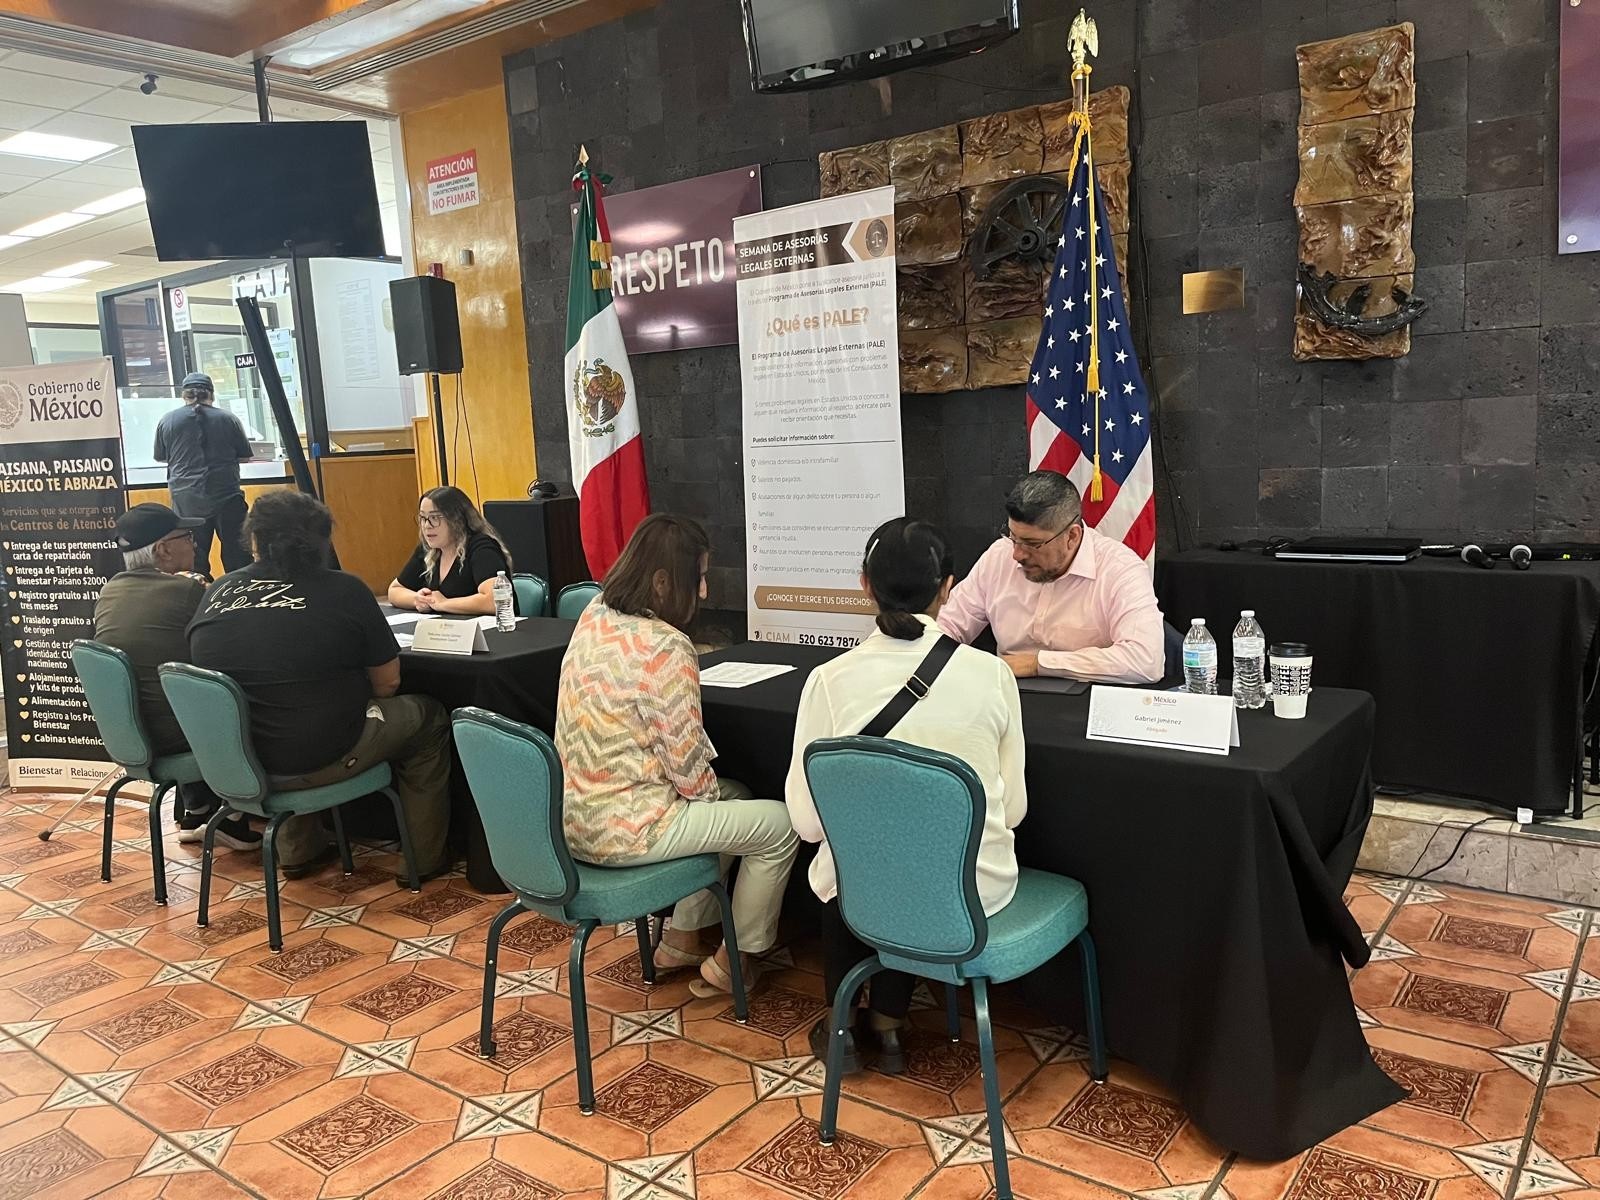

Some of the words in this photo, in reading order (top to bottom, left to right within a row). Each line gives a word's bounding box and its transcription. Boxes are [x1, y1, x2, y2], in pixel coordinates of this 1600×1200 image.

[429, 156, 474, 180] ATENCIÓN
[432, 198, 445, 210] NO
[446, 190, 477, 207] FUMAR
[740, 244, 771, 258] SEMANA
[772, 242, 783, 252] DE
[785, 233, 829, 250] ASESORÍAS
[611, 237, 725, 296] RESPETO
[740, 258, 773, 274] LEGALES
[774, 253, 815, 269] EXTERNAS
[769, 294, 793, 303] Programa
[766, 314, 801, 337] ¿Qué
[804, 316, 820, 330] es
[823, 307, 869, 328] PALE?
[757, 351, 782, 361] Programa
[783, 349, 790, 357] de
[838, 343, 865, 351] Externas
[866, 340, 886, 350] (PALE)
[236, 355, 254, 367] CAJA
[28, 381, 84, 396] Gobierno
[86, 378, 102, 392] de
[29, 394, 103, 422] México
[788, 434, 817, 442] información
[0, 461, 51, 477] AISANA,
[53, 457, 114, 474] PAISANO
[46, 478, 62, 491] TE
[64, 475, 118, 491] ABRAZA
[1, 506, 40, 517] Servicios
[41, 507, 57, 518] que
[69, 506, 99, 517] otorgan
[102, 506, 116, 514] en
[10, 519, 54, 531] Centros
[56, 518, 70, 530] de
[73, 517, 119, 531] Atenció
[11, 541, 41, 552] Entrega
[42, 541, 52, 550] de
[54, 541, 66, 550] tus
[68, 540, 119, 553] pertenencia
[12, 552, 31, 561] carta
[33, 551, 44, 560] de
[45, 550, 91, 562] repatriación
[14, 566, 44, 577] Entrega
[45, 566, 55, 575] de
[56, 566, 82, 577] Tarjeta
[83, 566, 94, 575] de
[16, 577, 51, 586] Bienestar
[53, 577, 82, 586] Paisano
[18, 591, 48, 602] Registro
[49, 591, 81, 602] gratuito
[82, 591, 90, 600] al
[766, 593, 794, 602] ¡CONOCE
[794, 594, 799, 602] Y
[800, 595, 822, 604] EJERCE
[822, 596, 835, 605] TUS
[20, 602, 33, 610] tres
[34, 602, 58, 610] meses
[22, 615, 51, 625] Traslado
[52, 616, 84, 627] gratuito
[23, 625, 32, 634] de
[33, 625, 55, 636] origen
[25, 639, 50, 648] Gestión
[51, 640, 61, 649] de
[766, 631, 790, 643] CIAM
[799, 634, 815, 645] 520
[818, 635, 834, 646] 623
[26, 649, 60, 659] identidad:
[61, 651, 73, 659] CU
[27, 659, 68, 669] nacimiento
[29, 673, 73, 684] Alojamiento
[1280, 664, 1290, 696] COFFEE
[29, 684, 35, 693] y
[36, 682, 50, 692] kits
[51, 684, 60, 692] de
[61, 685, 85, 695] produ
[31, 696, 81, 708] Alimentación
[1153, 696, 1177, 704] México
[32, 711, 63, 721] Registro
[70, 712, 81, 721] los
[83, 713, 97, 722] Pro
[1134, 715, 1156, 723] Gabriel
[33, 720, 70, 730] Bienestar
[34, 734, 67, 744] Cabinas
[67, 736, 106, 746] telefónic
[19, 766, 63, 775] Bienestar
[70, 767, 109, 779] Relacione
